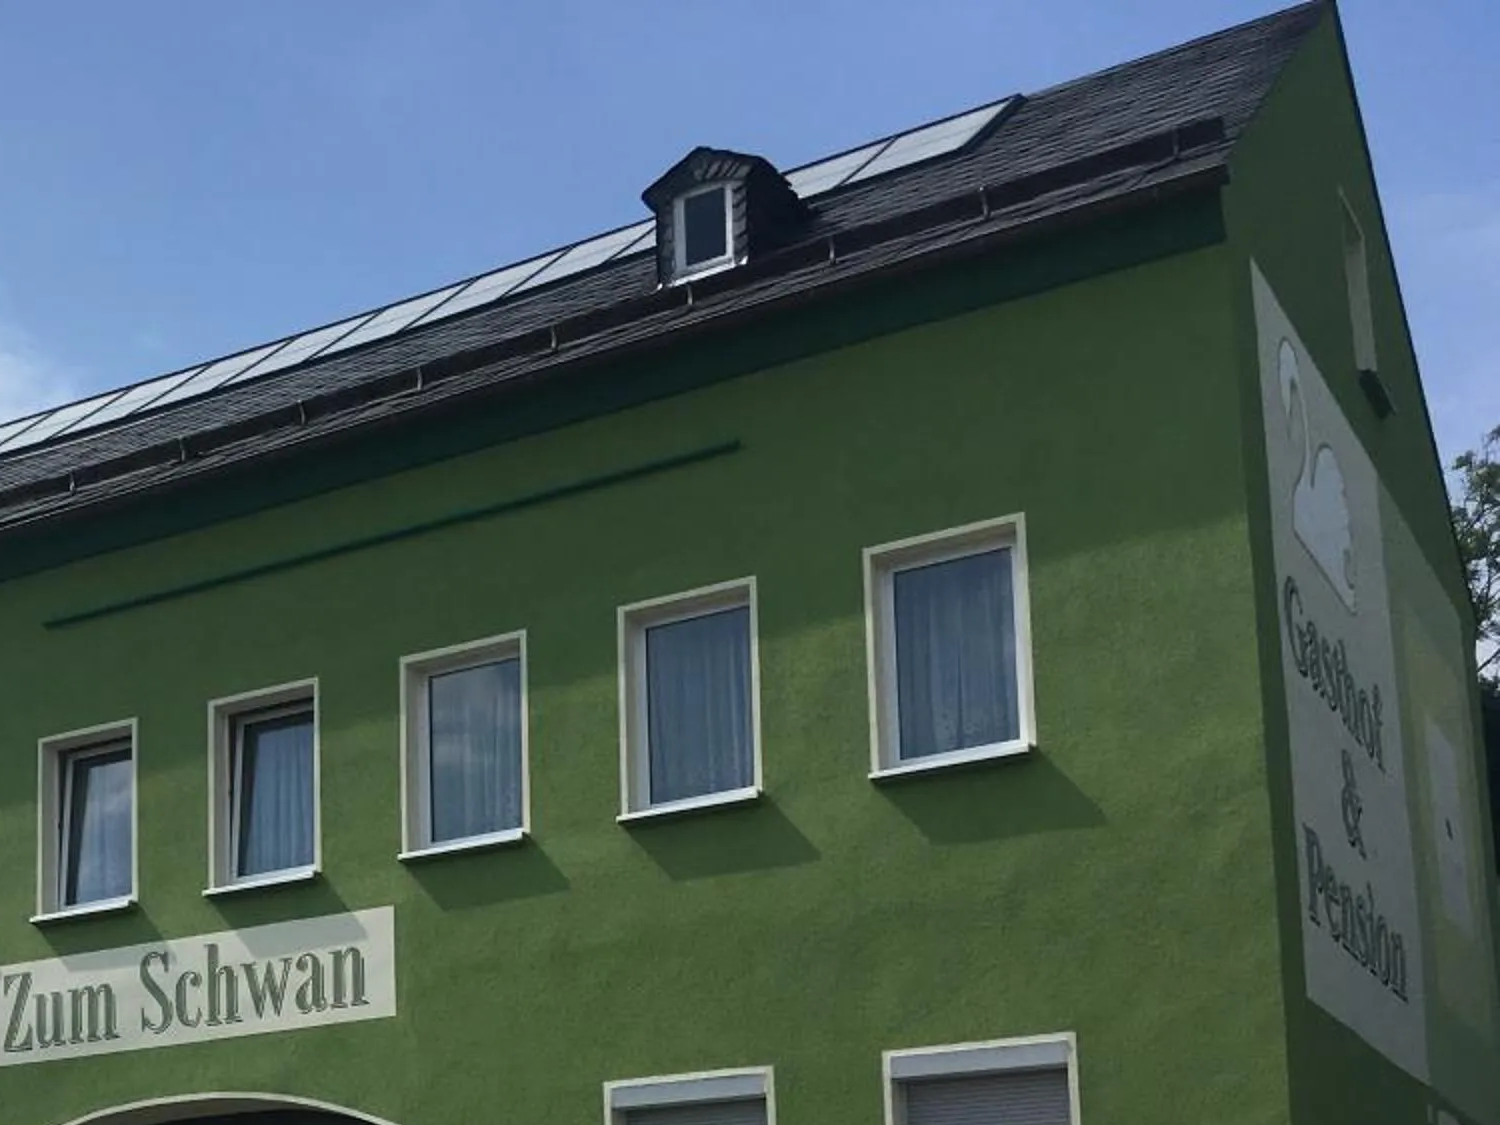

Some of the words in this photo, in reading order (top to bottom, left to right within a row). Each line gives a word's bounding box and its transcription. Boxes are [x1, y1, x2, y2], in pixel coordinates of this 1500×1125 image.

[1283, 575, 1386, 774] Gasthof
[1340, 747, 1368, 861] &
[1302, 820, 1409, 1004] Pension
[3, 971, 120, 1053] Zum
[138, 943, 370, 1035] Schwan
